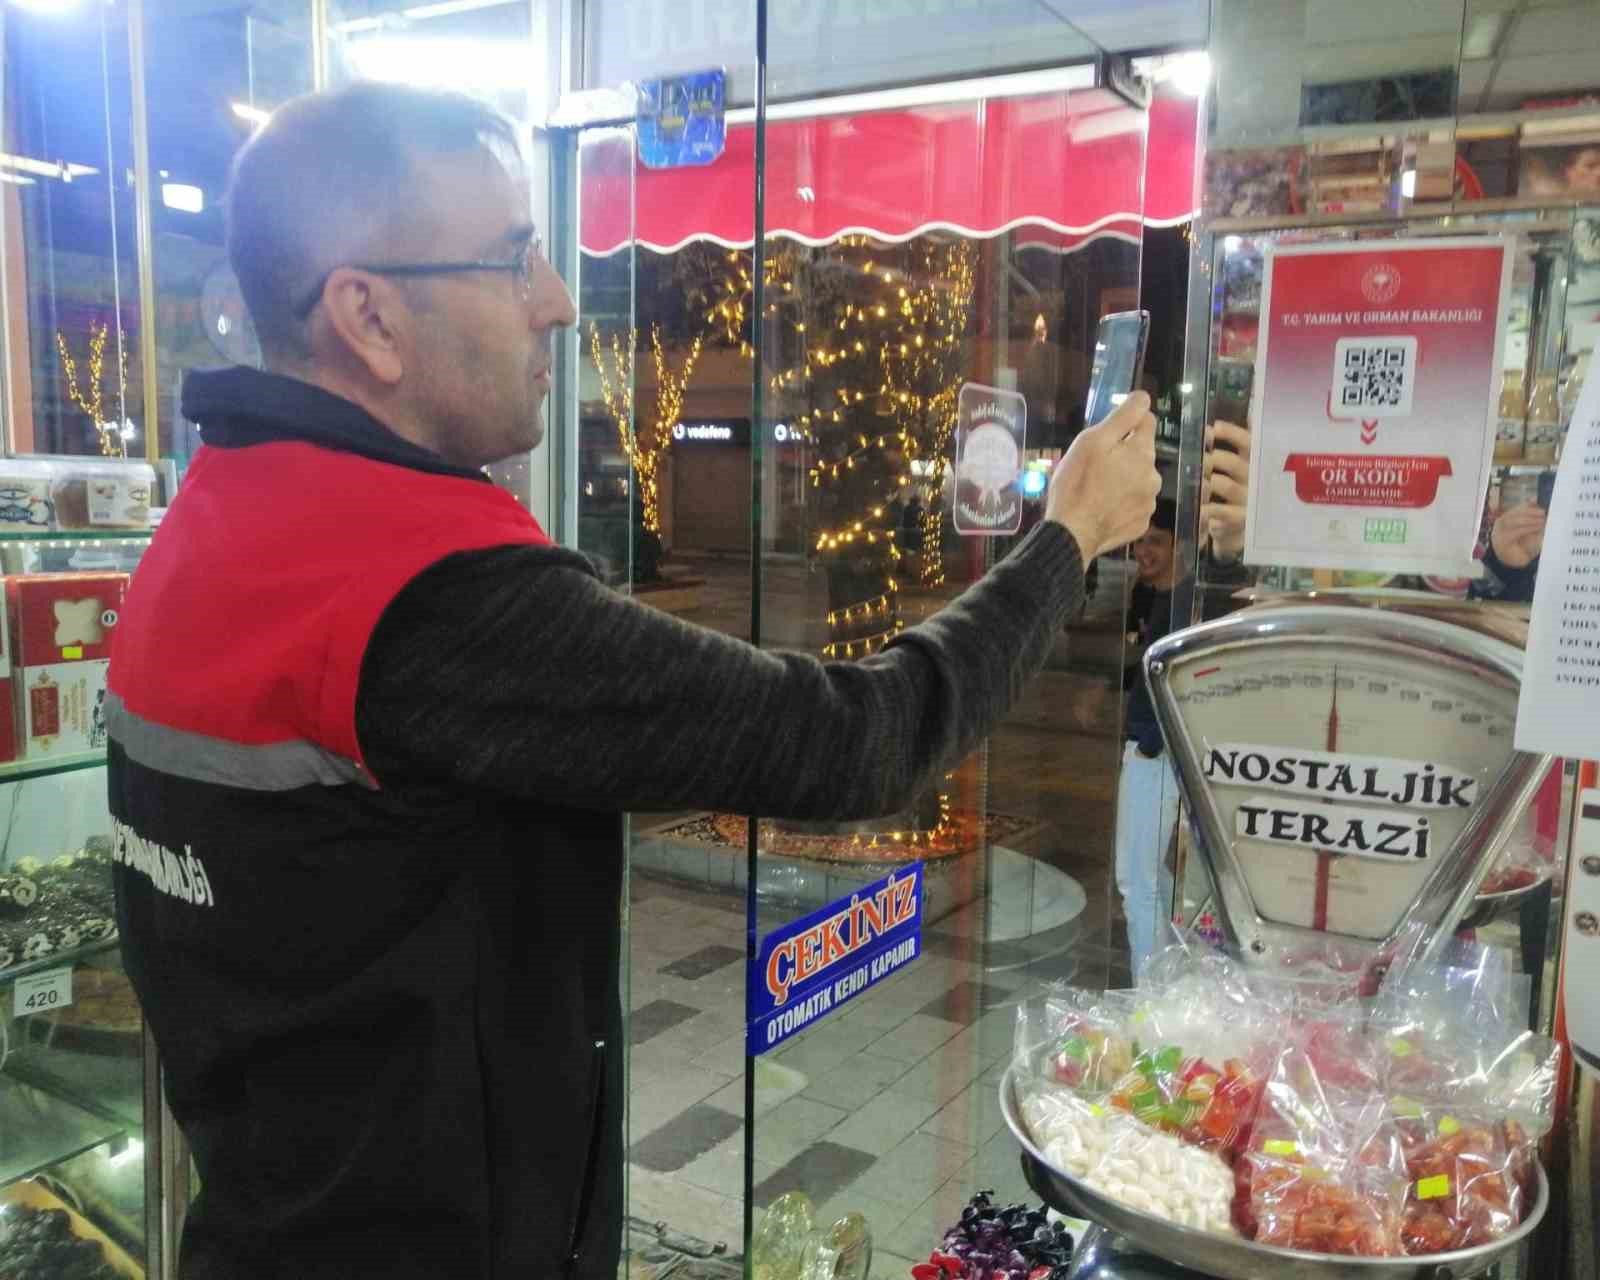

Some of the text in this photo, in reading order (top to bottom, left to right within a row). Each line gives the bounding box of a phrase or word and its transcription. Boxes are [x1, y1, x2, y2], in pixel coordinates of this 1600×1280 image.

[1304, 312, 1342, 325] TARIM
[1346, 311, 1361, 324] VE
[1363, 310, 1409, 324] ORMAN
[687, 424, 731, 440] vodafone
[1321, 469, 1411, 487] QR KODU
[1205, 749, 1475, 808] NOSTALJİK
[1238, 805, 1430, 859] TERAZİ
[766, 872, 918, 1006] ÇEKİNİZ
[25, 990, 57, 1008] 420
[767, 937, 916, 1044] OTOMATİK KENDİ KAPANIR
